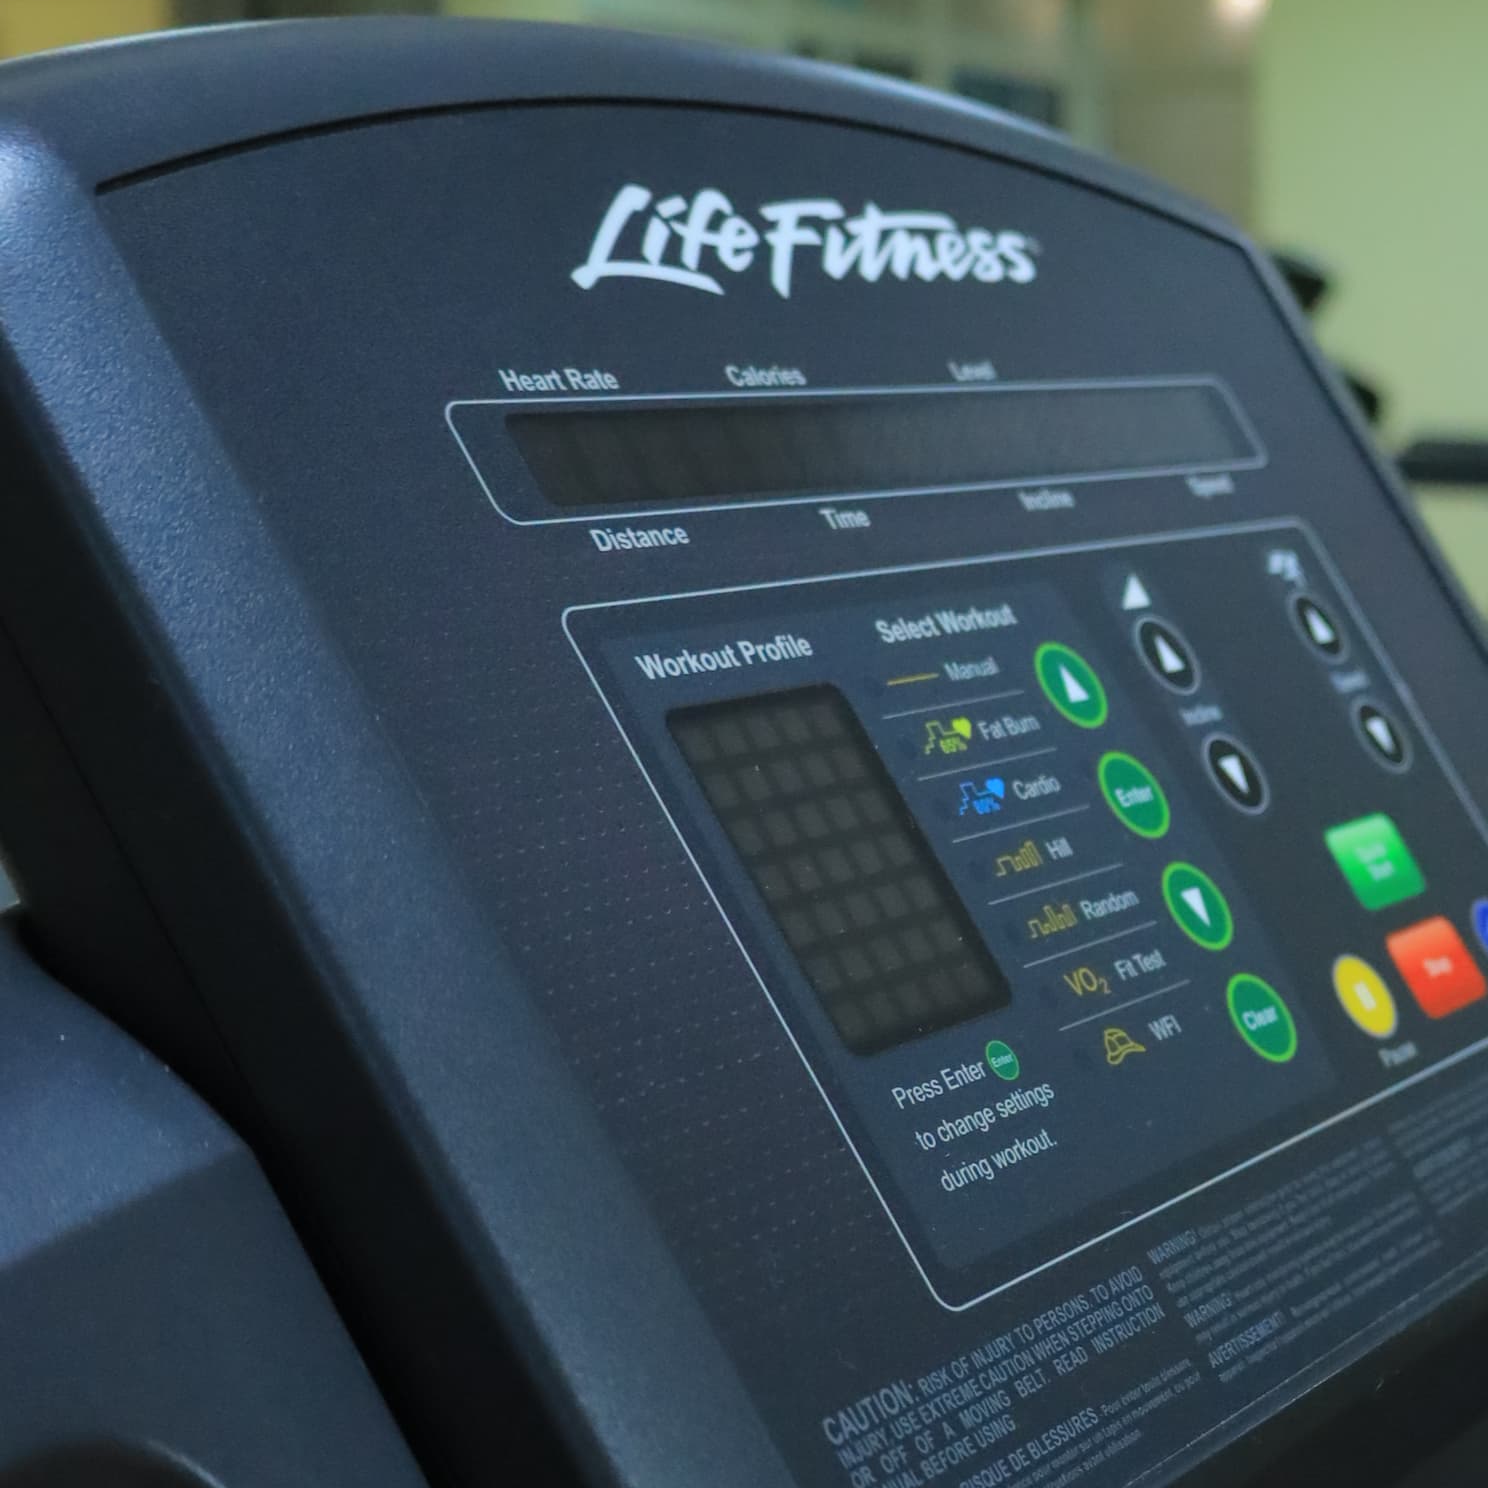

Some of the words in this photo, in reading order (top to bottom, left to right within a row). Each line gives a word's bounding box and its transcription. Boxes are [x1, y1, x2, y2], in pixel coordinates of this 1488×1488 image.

[570, 183, 761, 295] Life
[759, 198, 1038, 299] Fitness
[499, 368, 567, 392] Heart
[563, 367, 620, 391] Rate
[725, 364, 808, 388] Calories
[818, 508, 871, 530] Time
[589, 525, 691, 552] Distance
[874, 614, 941, 644] Select
[936, 603, 1018, 634] Workout
[635, 643, 742, 680] Workout
[736, 632, 814, 665] Profile
[943, 656, 1000, 682] Manual
[977, 720, 1007, 741] Fat
[1012, 773, 1063, 800] Cardio
[1114, 786, 1154, 808] Enter
[1045, 836, 1074, 860] Hill
[1079, 890, 1140, 920] Random
[1113, 956, 1139, 981] Fit
[1132, 948, 1167, 974] Test
[1242, 1005, 1279, 1031] Clear
[891, 1079, 943, 1110] Press
[940, 1061, 987, 1091] Enter
[914, 1131, 937, 1151] to
[936, 1106, 996, 1142] change
[995, 1083, 1055, 1118] settings
[940, 1158, 994, 1192] during
[991, 1128, 1058, 1168] workout.
[821, 1378, 920, 1445] CAUTION:
[917, 1367, 952, 1397] RISK
[951, 1356, 970, 1379] OF
[970, 1332, 1016, 1369] INJURY
[1013, 1323, 1035, 1344] TO
[1089, 1284, 1110, 1304] TO
[1108, 1265, 1143, 1296] AVOID
[890, 1411, 922, 1439] USE
[918, 1378, 982, 1425] EXTREME
[979, 1349, 1035, 1390] CAUTION
[1031, 1330, 1070, 1361] WHEN
[1067, 1301, 1124, 1342] STEPPING
[1121, 1284, 1154, 1312] ONTO
[880, 1444, 907, 1473] OFF
[914, 1430, 934, 1454] OF
[942, 1421, 956, 1440] A
[958, 1389, 1012, 1430] MOVING
[1053, 1346, 1089, 1376] READ
[1091, 1302, 1165, 1353] INSTRUCTION
[919, 1435, 977, 1480] BEFORE
[974, 1414, 1016, 1449] USING
[1008, 1448, 1030, 1472] DE
